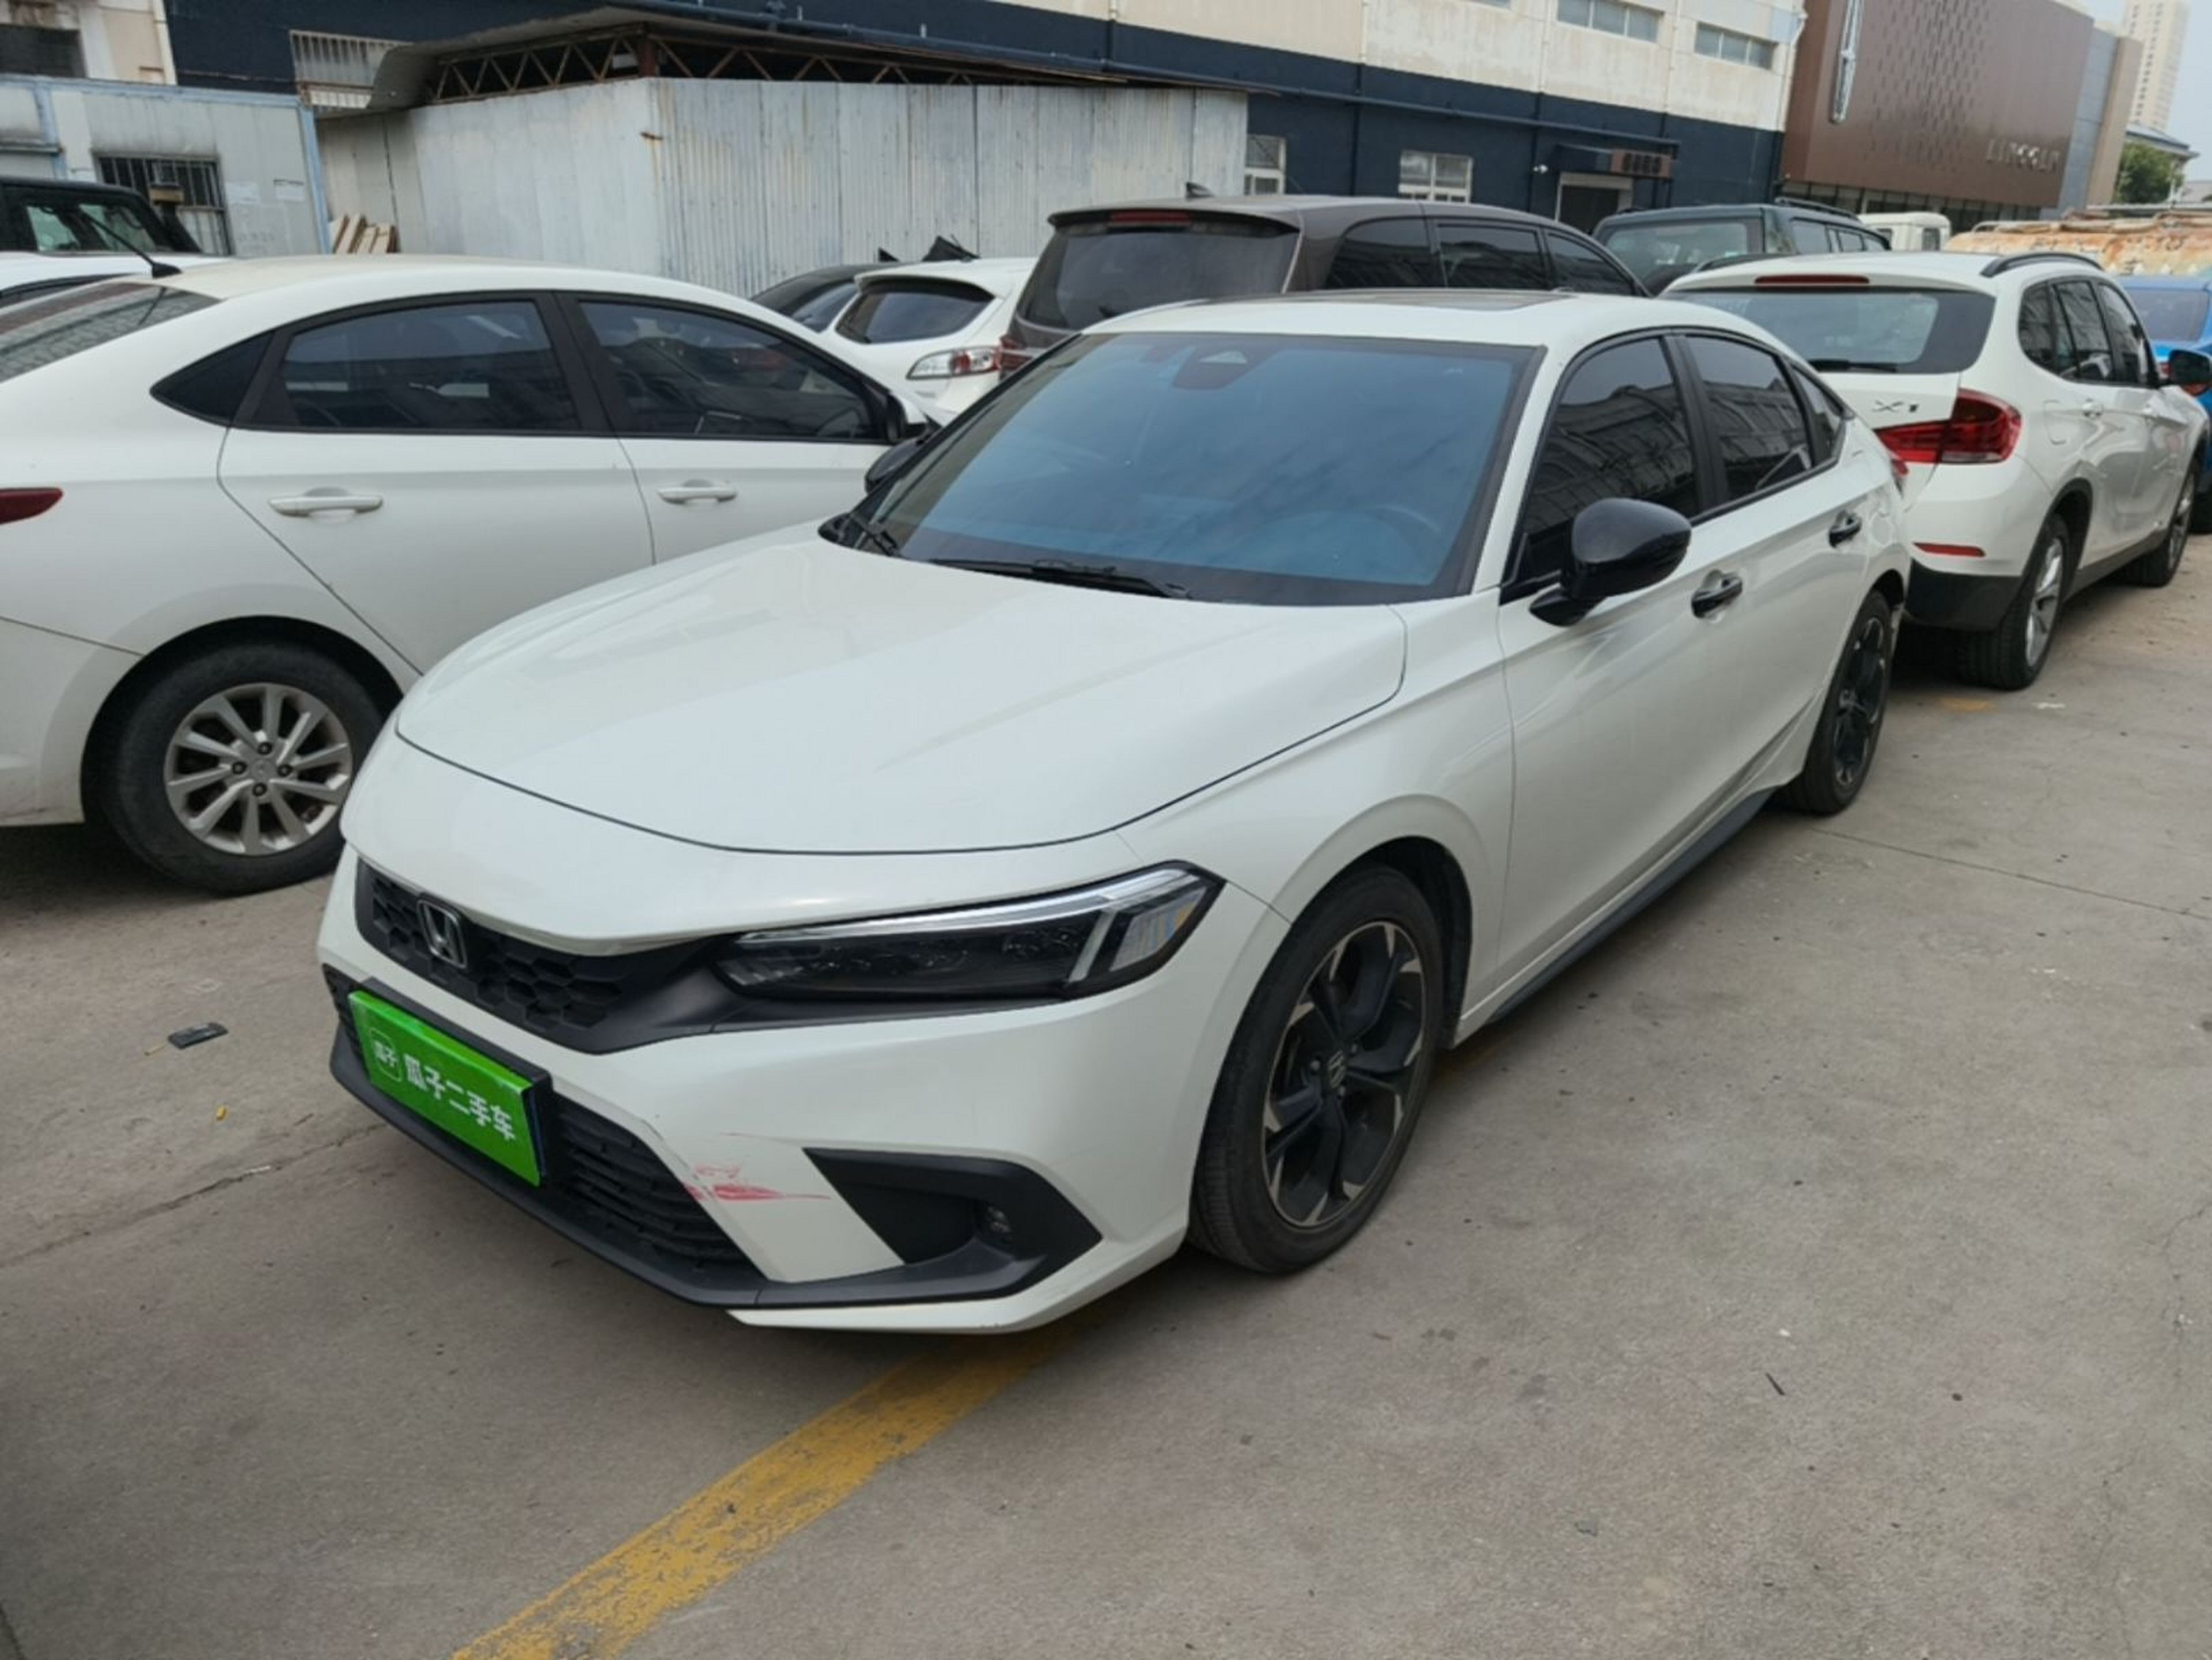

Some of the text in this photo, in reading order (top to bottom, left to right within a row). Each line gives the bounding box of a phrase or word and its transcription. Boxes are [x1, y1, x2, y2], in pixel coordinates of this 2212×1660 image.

[404, 1052, 516, 1141] 瓜子二手车
